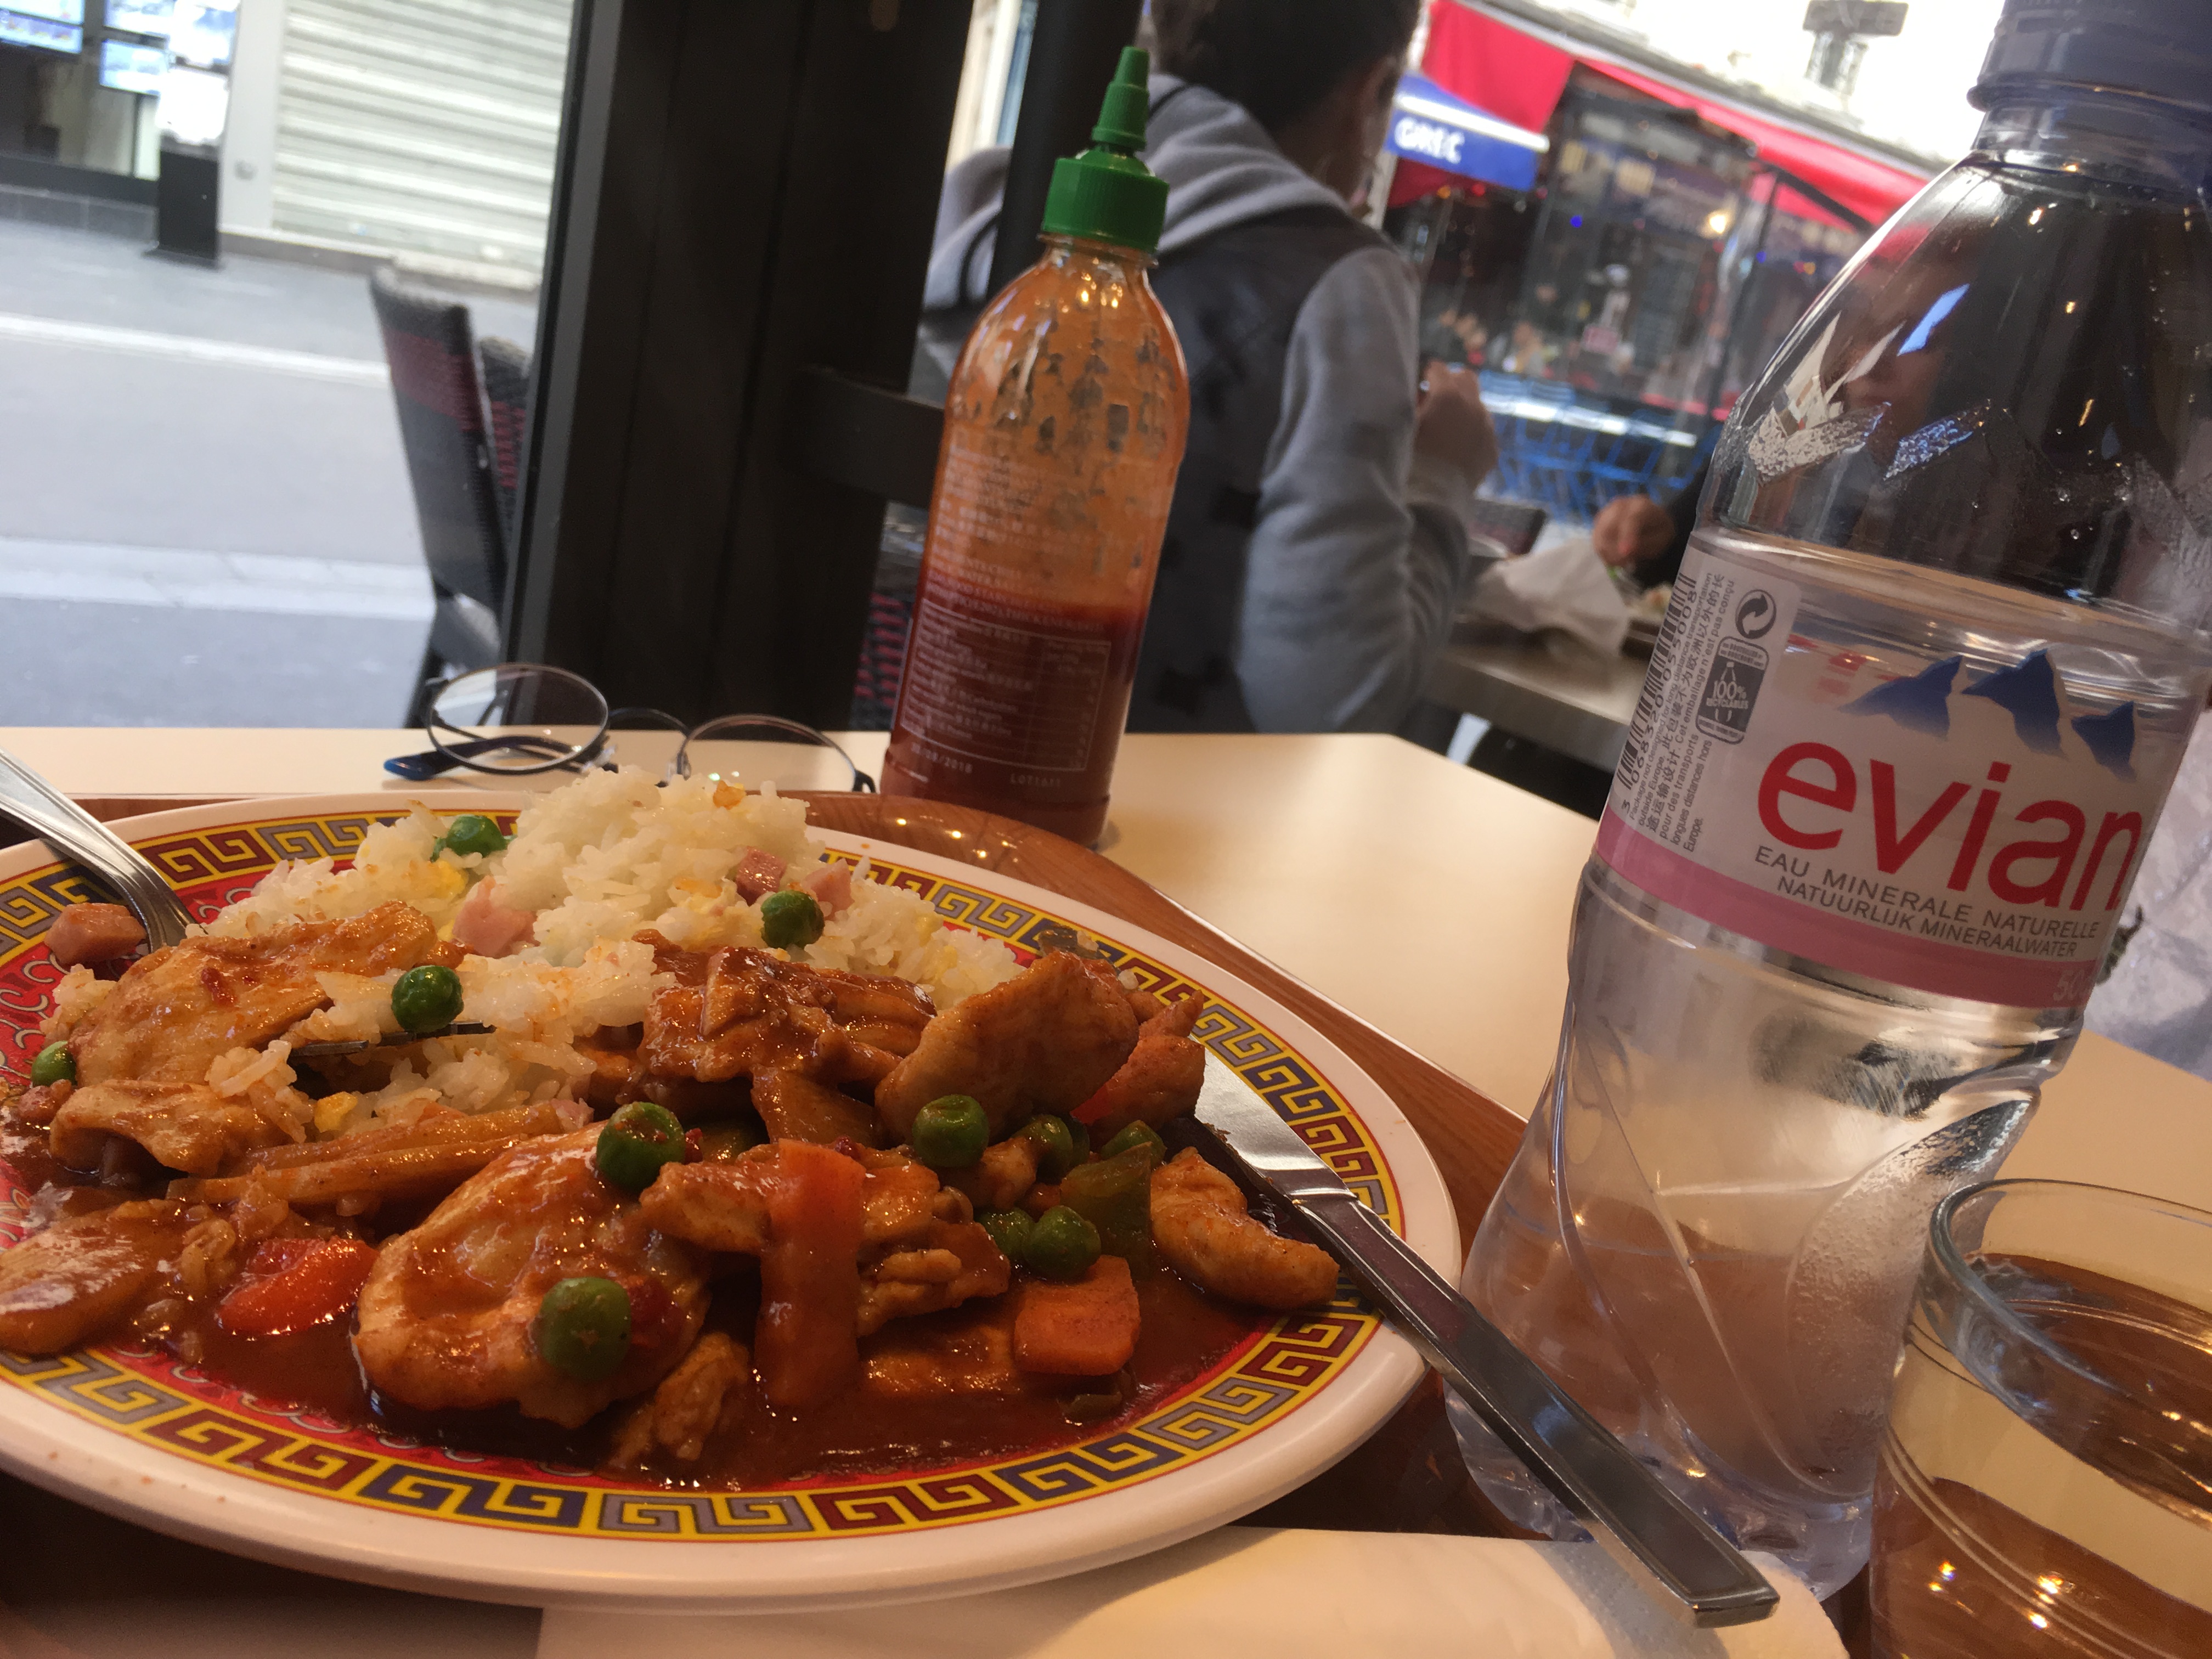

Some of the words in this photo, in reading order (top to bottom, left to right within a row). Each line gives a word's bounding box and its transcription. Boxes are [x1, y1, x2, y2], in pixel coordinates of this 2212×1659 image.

[1620, 799, 1631, 814] 3
[1629, 694, 1665, 783] 068320
[1661, 589, 1698, 681] 055008
[1628, 780, 1646, 820] Package
[1642, 763, 1651, 778] not
[1647, 719, 1666, 761] designed
[1661, 705, 1670, 718] for
[1666, 683, 1678, 704] long
[1673, 641, 1690, 681] distance
[1686, 572, 1712, 639] transportation
[1674, 724, 1688, 744] Cet
[1681, 667, 1706, 723] emballage
[1700, 637, 1715, 665] n'est
[1711, 616, 1723, 637] pas
[1719, 579, 1735, 614] conçu
[1712, 680, 1747, 699] 100%
[1638, 791, 1654, 826] outside
[1648, 754, 1666, 790] Europe.
[1659, 810, 1673, 839] pour
[1666, 791, 1680, 811] des
[1674, 733, 1699, 790] transports
[1669, 808, 1689, 845] longues
[1681, 761, 1705, 808] distances
[1696, 739, 1712, 761] hors
[1683, 816, 1703, 852] Europe.
[1758, 742, 2142, 911] evian
[1756, 845, 1809, 877] EAU
[1822, 870, 1972, 923] MINERALE
[1983, 910, 2100, 939] NATURELLE
[1777, 877, 1915, 930] NATUURLIJK
[1921, 918, 2078, 957] MINERAALWATER
